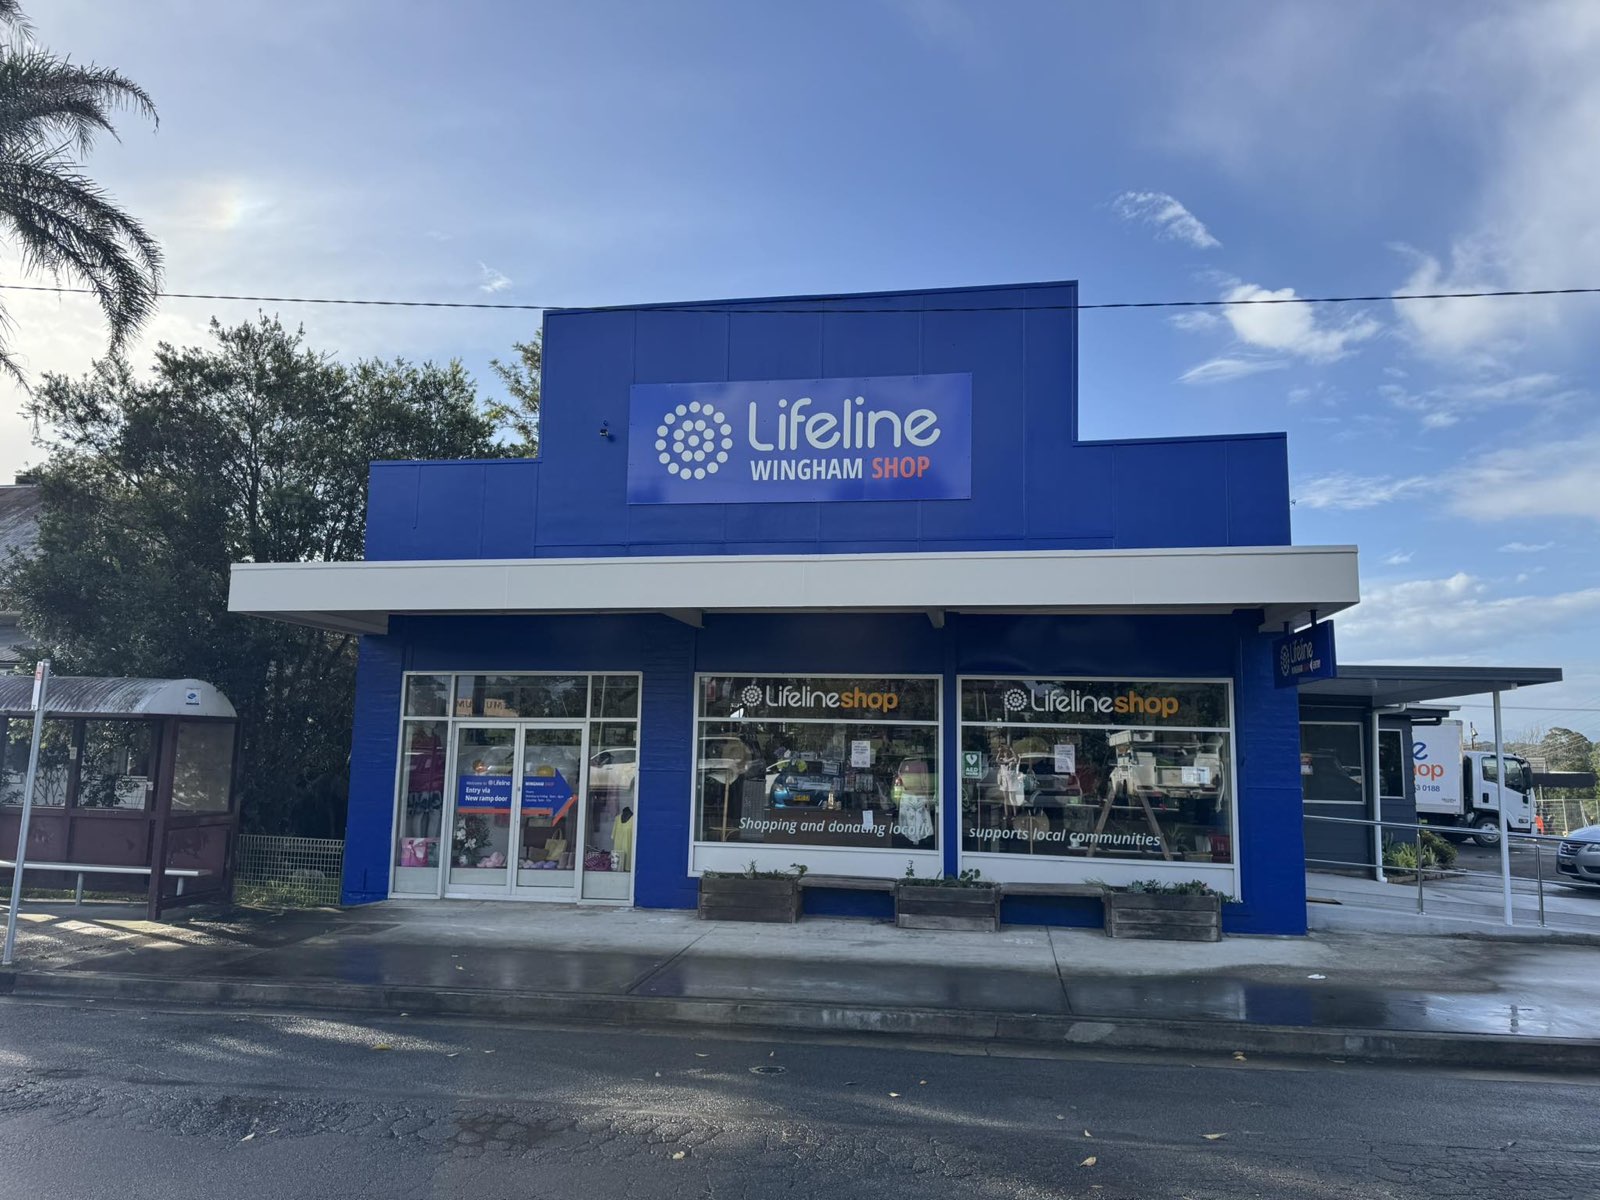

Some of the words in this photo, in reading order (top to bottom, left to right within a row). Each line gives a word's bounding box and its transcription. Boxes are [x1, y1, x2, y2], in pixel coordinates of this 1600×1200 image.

[749, 396, 941, 451] Lifeline
[750, 458, 863, 481] WINGHAM
[871, 456, 930, 479] SHOP
[1413, 763, 1444, 781] op
[465, 786, 481, 795] Entry
[1422, 784, 1441, 792] 0188
[738, 817, 797, 834] Shopping
[800, 819, 826, 832] and
[969, 827, 1029, 842] supports
[1032, 828, 1066, 842] local
[1069, 831, 1161, 847] communities
